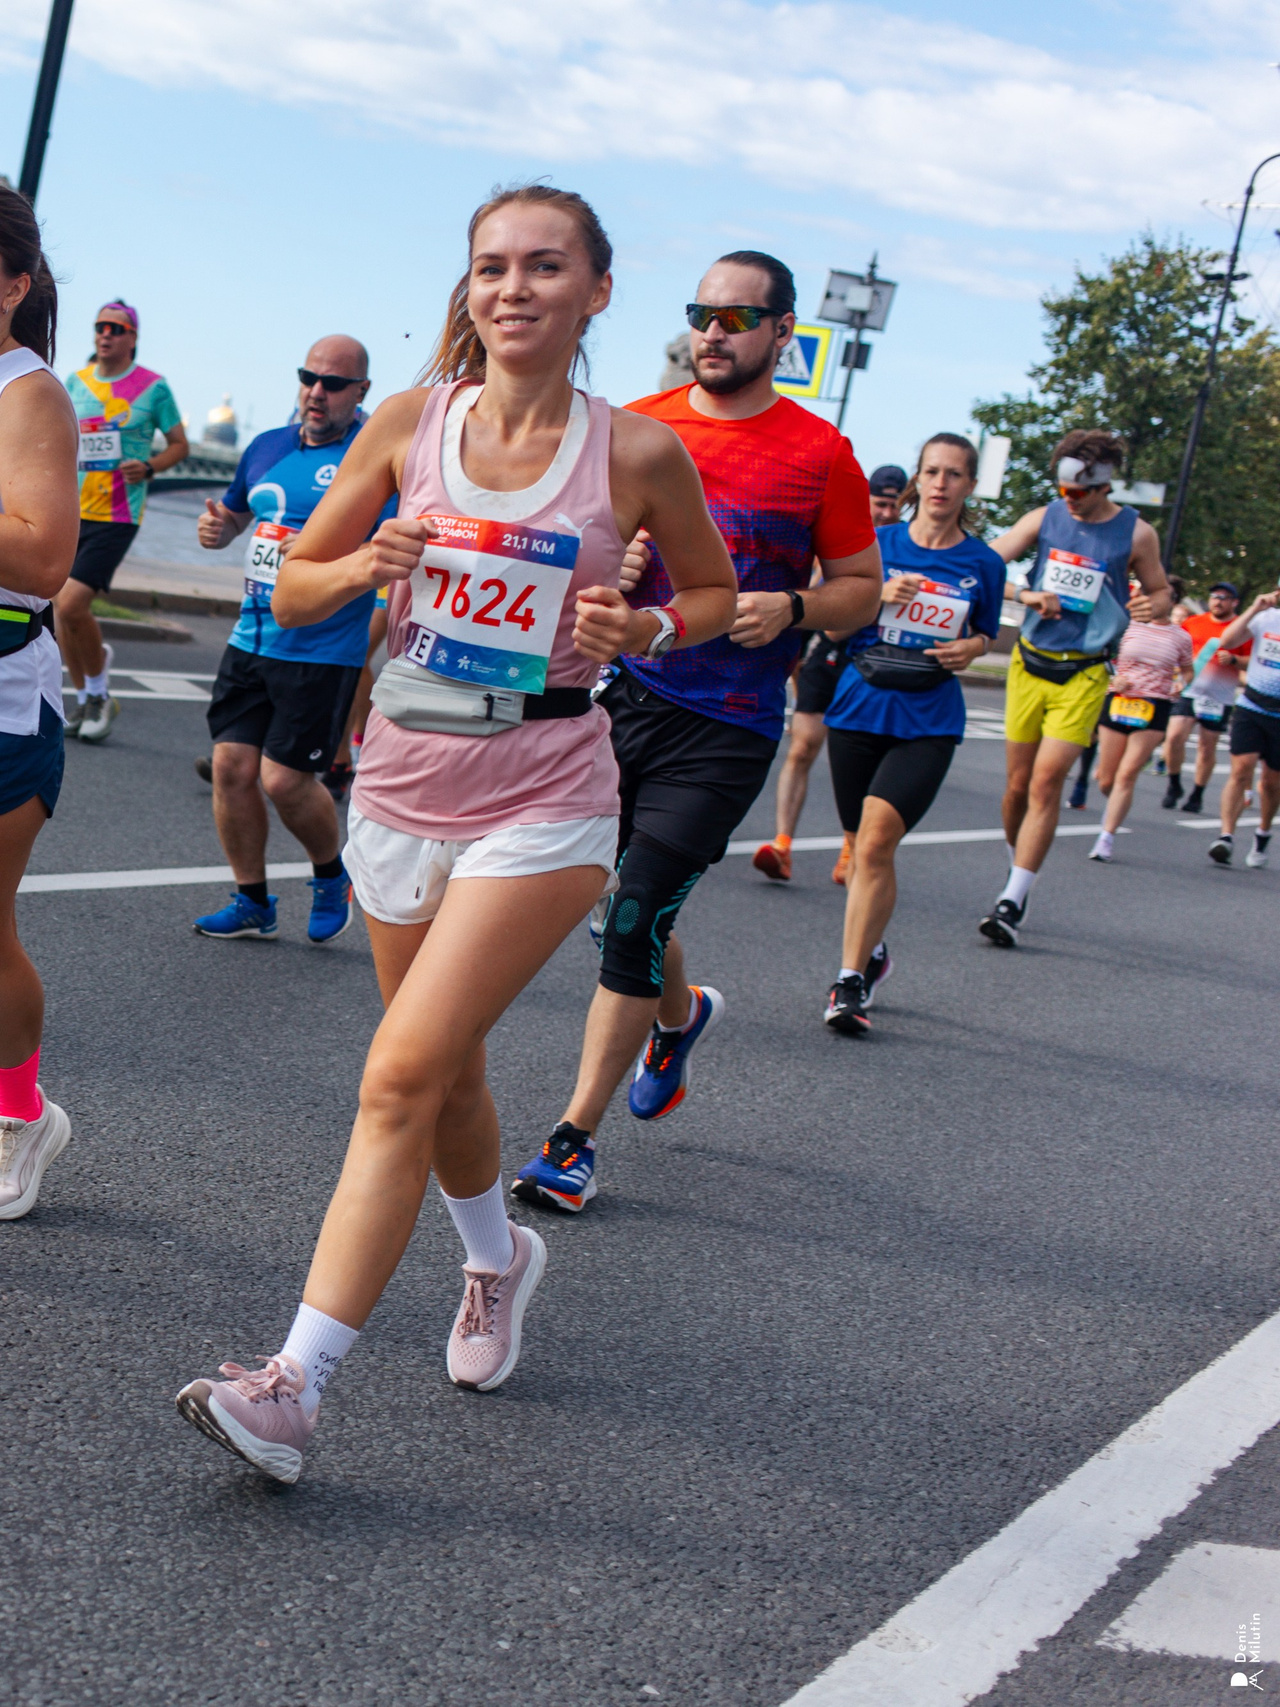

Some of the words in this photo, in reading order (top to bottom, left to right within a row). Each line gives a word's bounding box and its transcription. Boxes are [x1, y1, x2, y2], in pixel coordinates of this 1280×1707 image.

[436, 526, 478, 540] АРАФОН
[501, 533, 528, 550] 21,1
[531, 539, 556, 555] КМ
[1050, 567, 1095, 590] 3289
[424, 566, 537, 632] 7624
[415, 633, 431, 659] E
